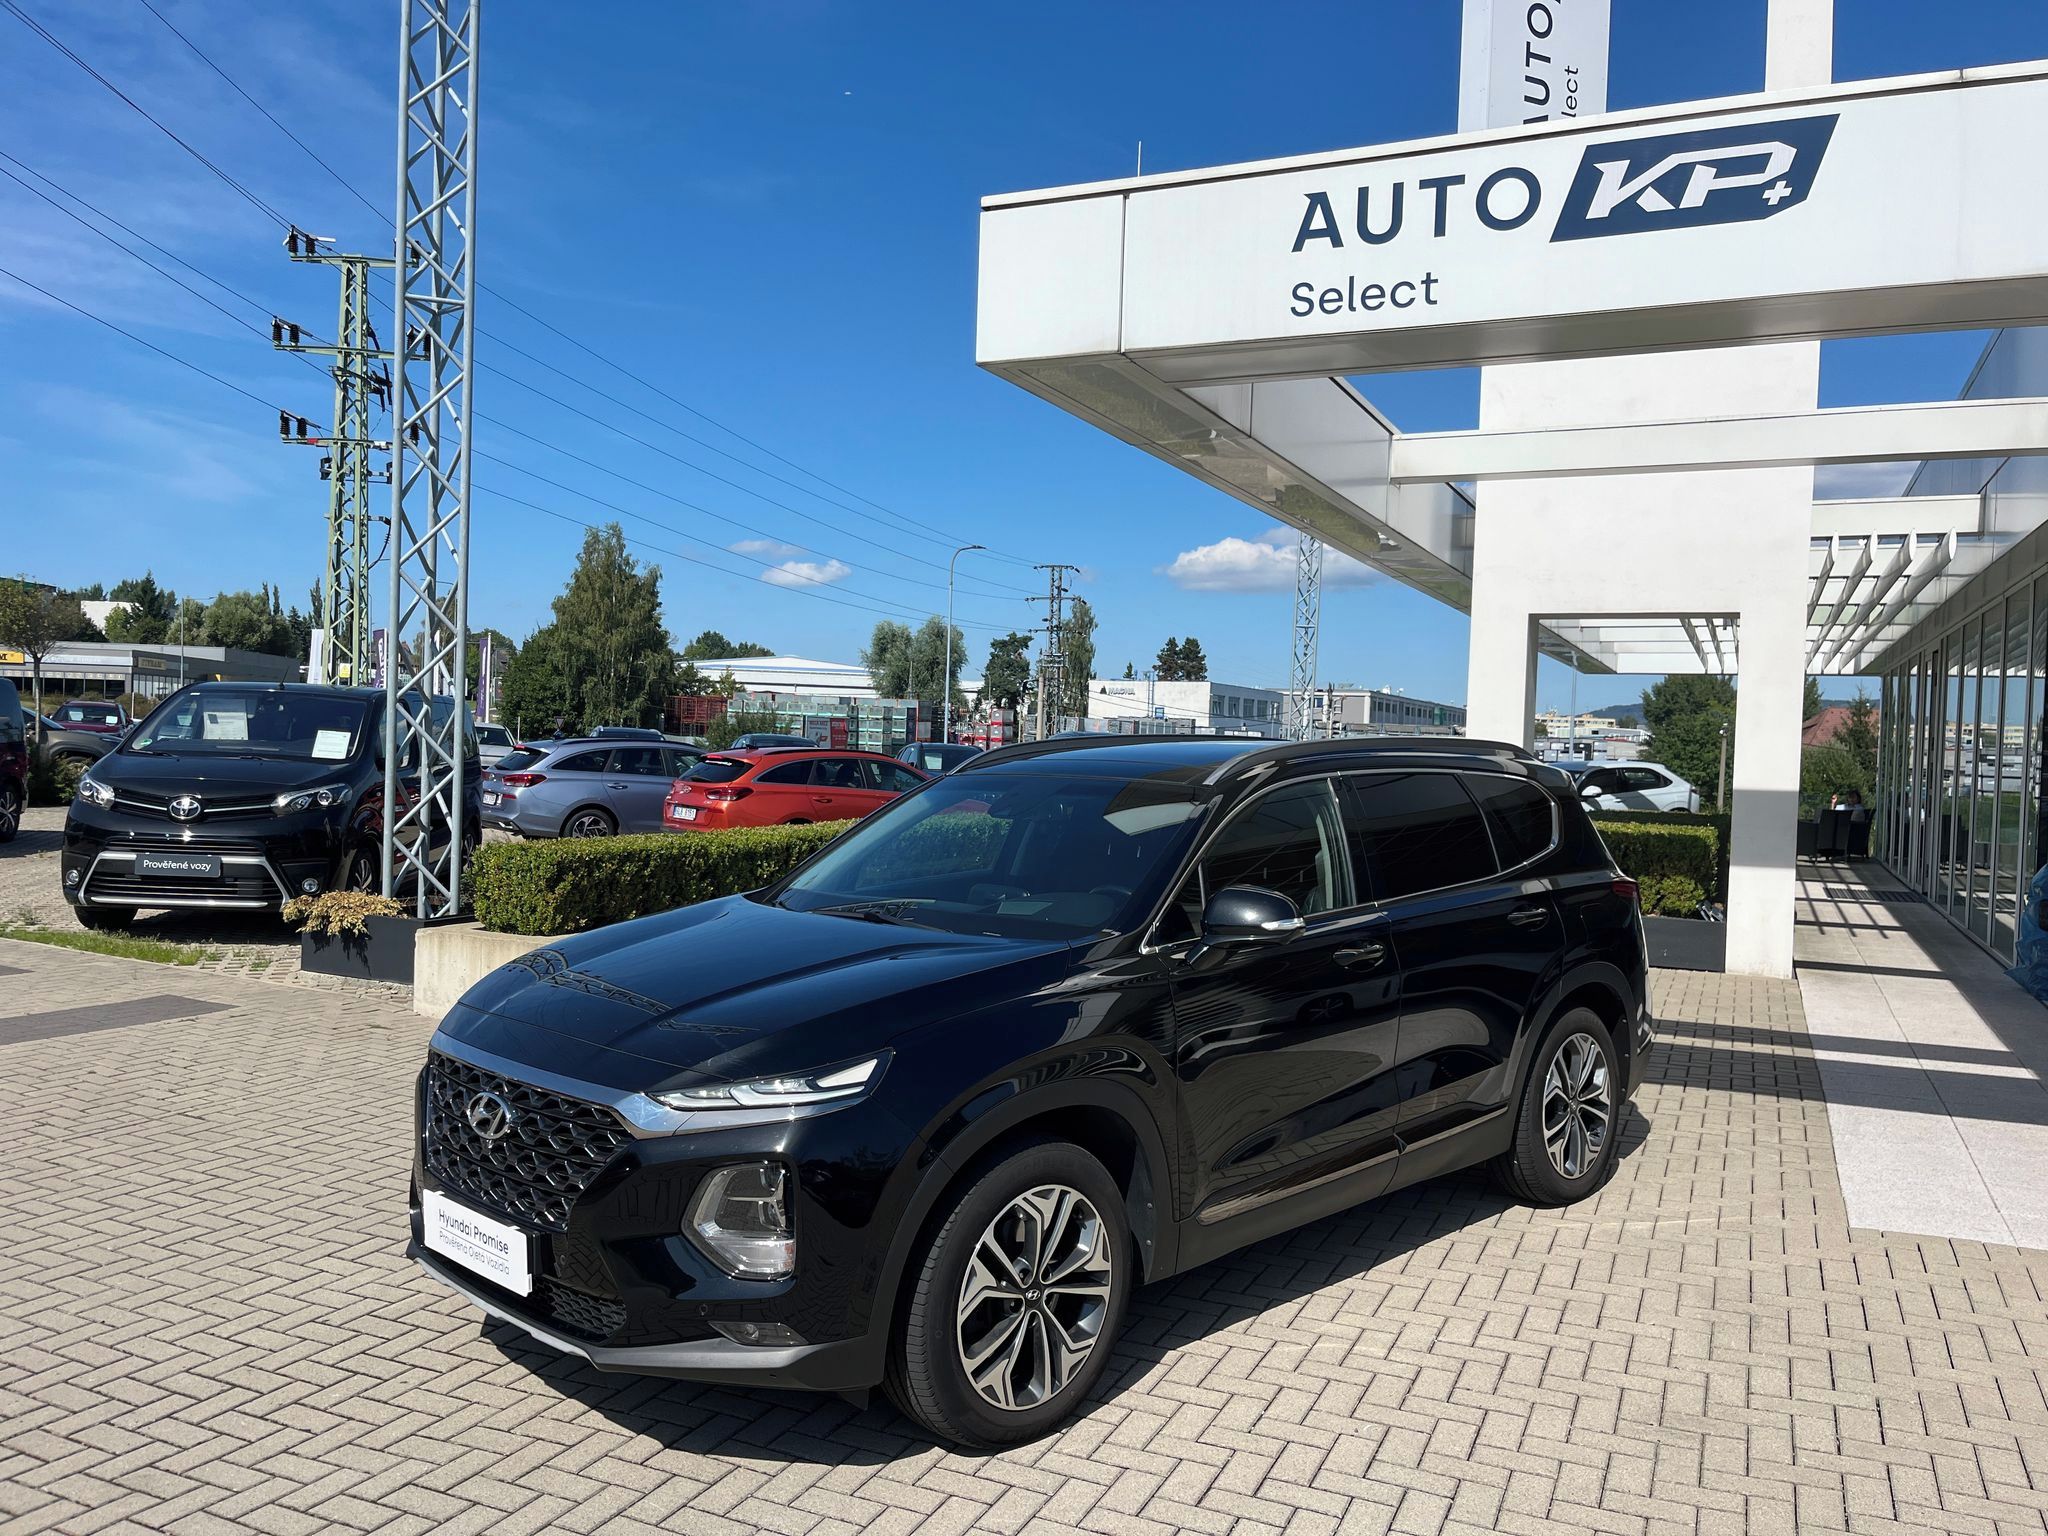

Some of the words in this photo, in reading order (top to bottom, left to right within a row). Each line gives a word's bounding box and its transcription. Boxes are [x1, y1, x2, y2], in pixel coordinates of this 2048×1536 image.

[1561, 65, 1578, 118] lect
[1291, 166, 1542, 253] AUTO
[1290, 271, 1439, 317] Select
[143, 859, 188, 870] Prověřené
[190, 863, 212, 872] vozy
[438, 1209, 473, 1238] Hyundai
[473, 1225, 509, 1255] Promise
